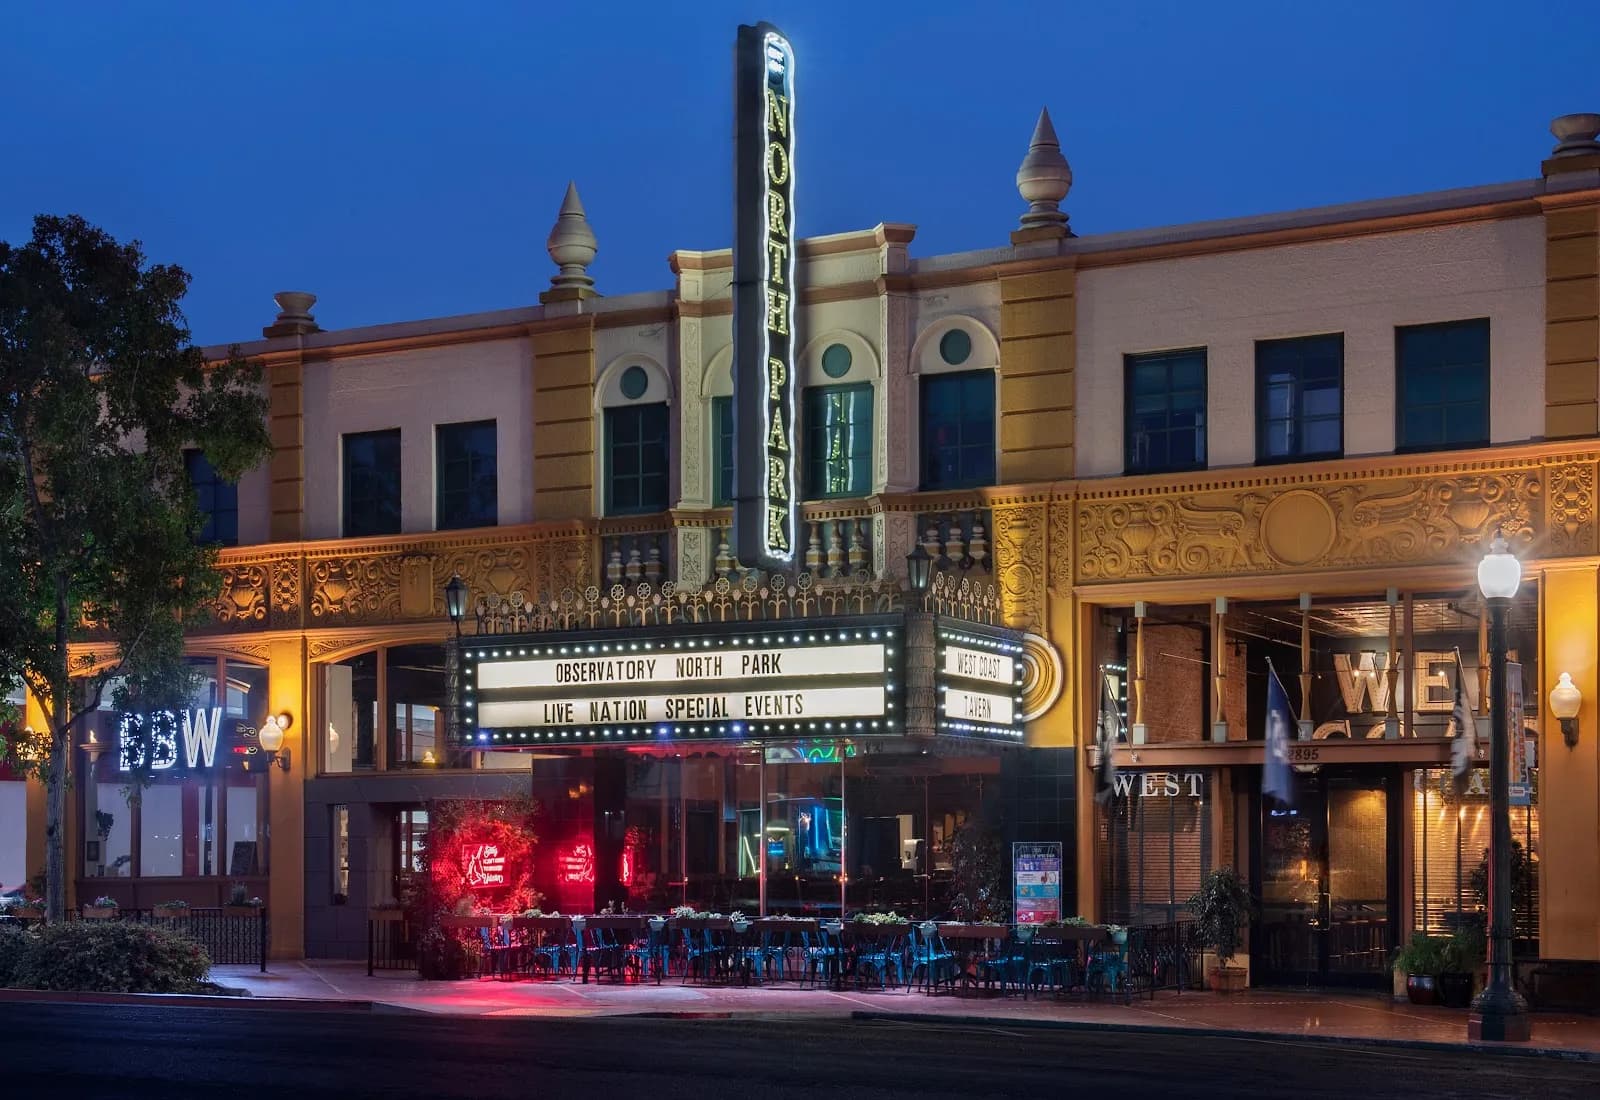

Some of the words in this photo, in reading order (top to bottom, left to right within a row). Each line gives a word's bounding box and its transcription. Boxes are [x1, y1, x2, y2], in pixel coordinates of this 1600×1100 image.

[767, 87, 791, 336] NORTH
[767, 357, 790, 550] PARK
[556, 659, 656, 683] OBSERVATORY
[676, 656, 722, 678] NORTH
[742, 653, 782, 675] PARK
[958, 651, 977, 676] WEST
[979, 655, 1001, 679] COAST
[543, 702, 574, 723] LIVE
[590, 700, 647, 721] NATION
[665, 698, 729, 719] SPECIAL
[745, 694, 804, 716] EVENTS
[964, 695, 992, 719] TAVERN
[1288, 748, 1319, 761] 2895
[1112, 772, 1204, 798] WEST
